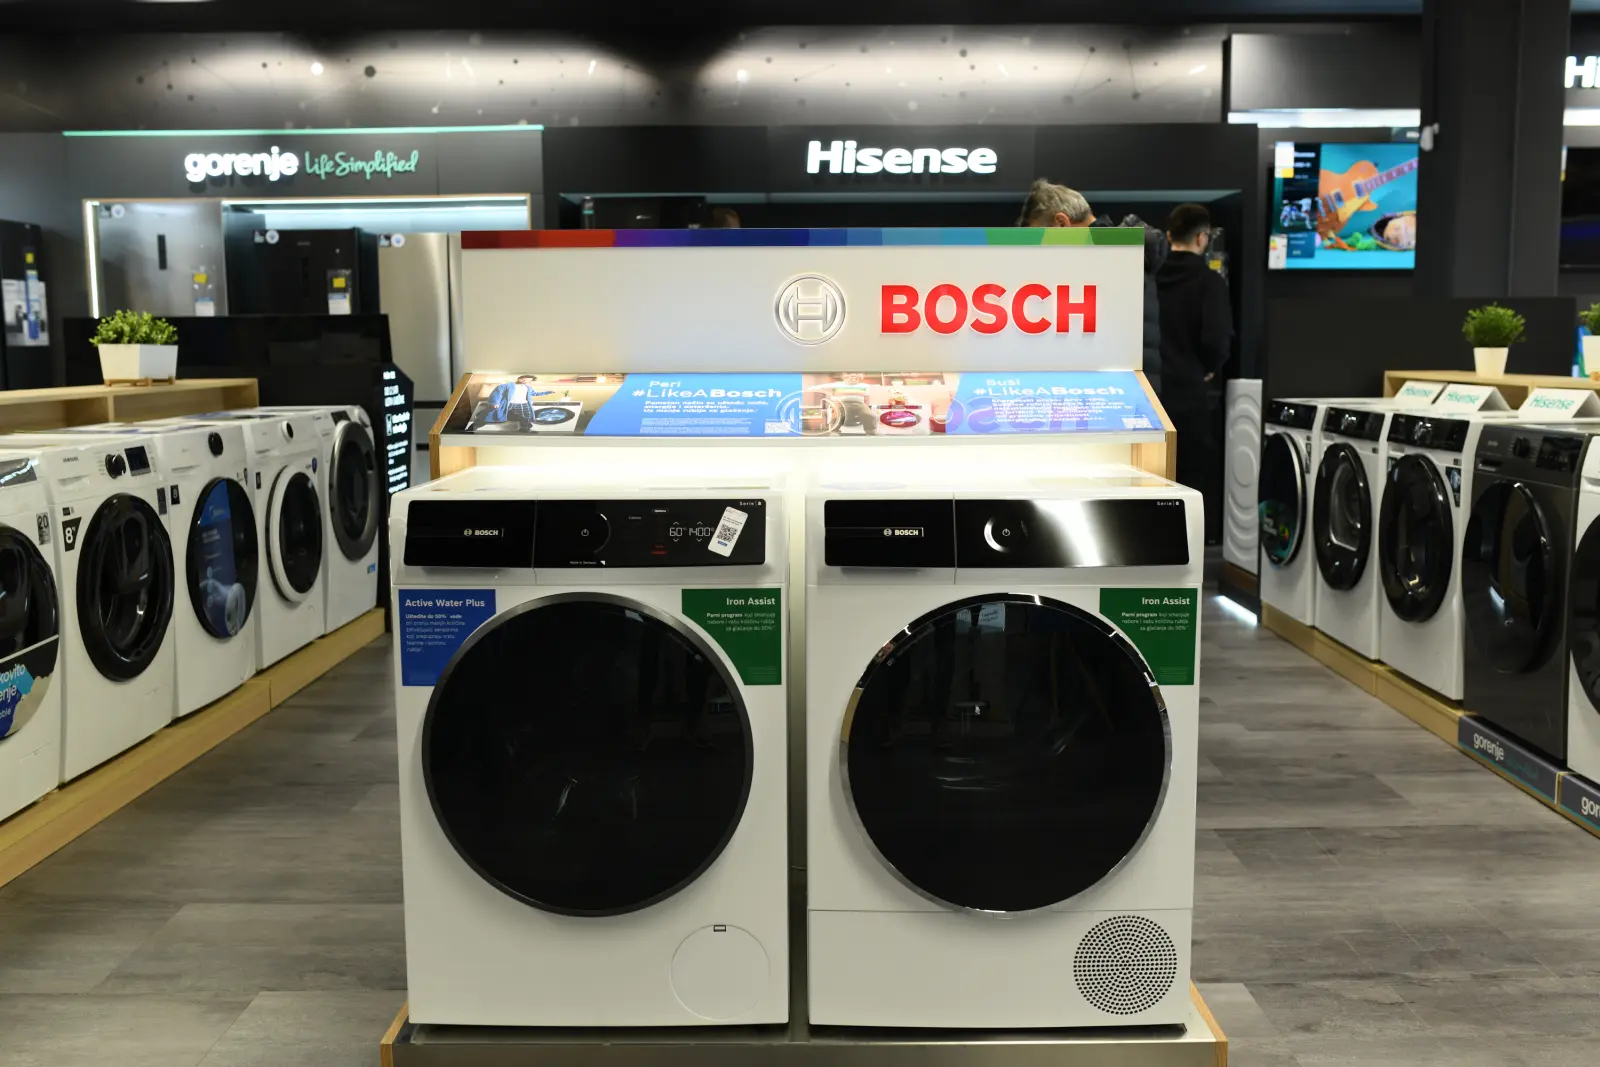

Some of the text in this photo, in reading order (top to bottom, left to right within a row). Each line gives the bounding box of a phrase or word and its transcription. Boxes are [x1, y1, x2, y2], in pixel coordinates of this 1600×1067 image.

[184, 146, 299, 183] gorenje
[806, 140, 998, 174] Hisense
[881, 283, 1097, 335] BOSCH
[632, 388, 782, 398] #LikeABosch
[974, 386, 1125, 396] #LikeABosch
[1529, 395, 1575, 411] Hisense
[37, 514, 49, 531] 20
[65, 527, 74, 544] 8
[688, 526, 711, 537] 1400
[405, 599, 485, 607] Active Water Plus
[726, 596, 776, 606] Iron Assist
[1142, 596, 1191, 605] Iron Assist
[1473, 733, 1505, 761] gorenje
